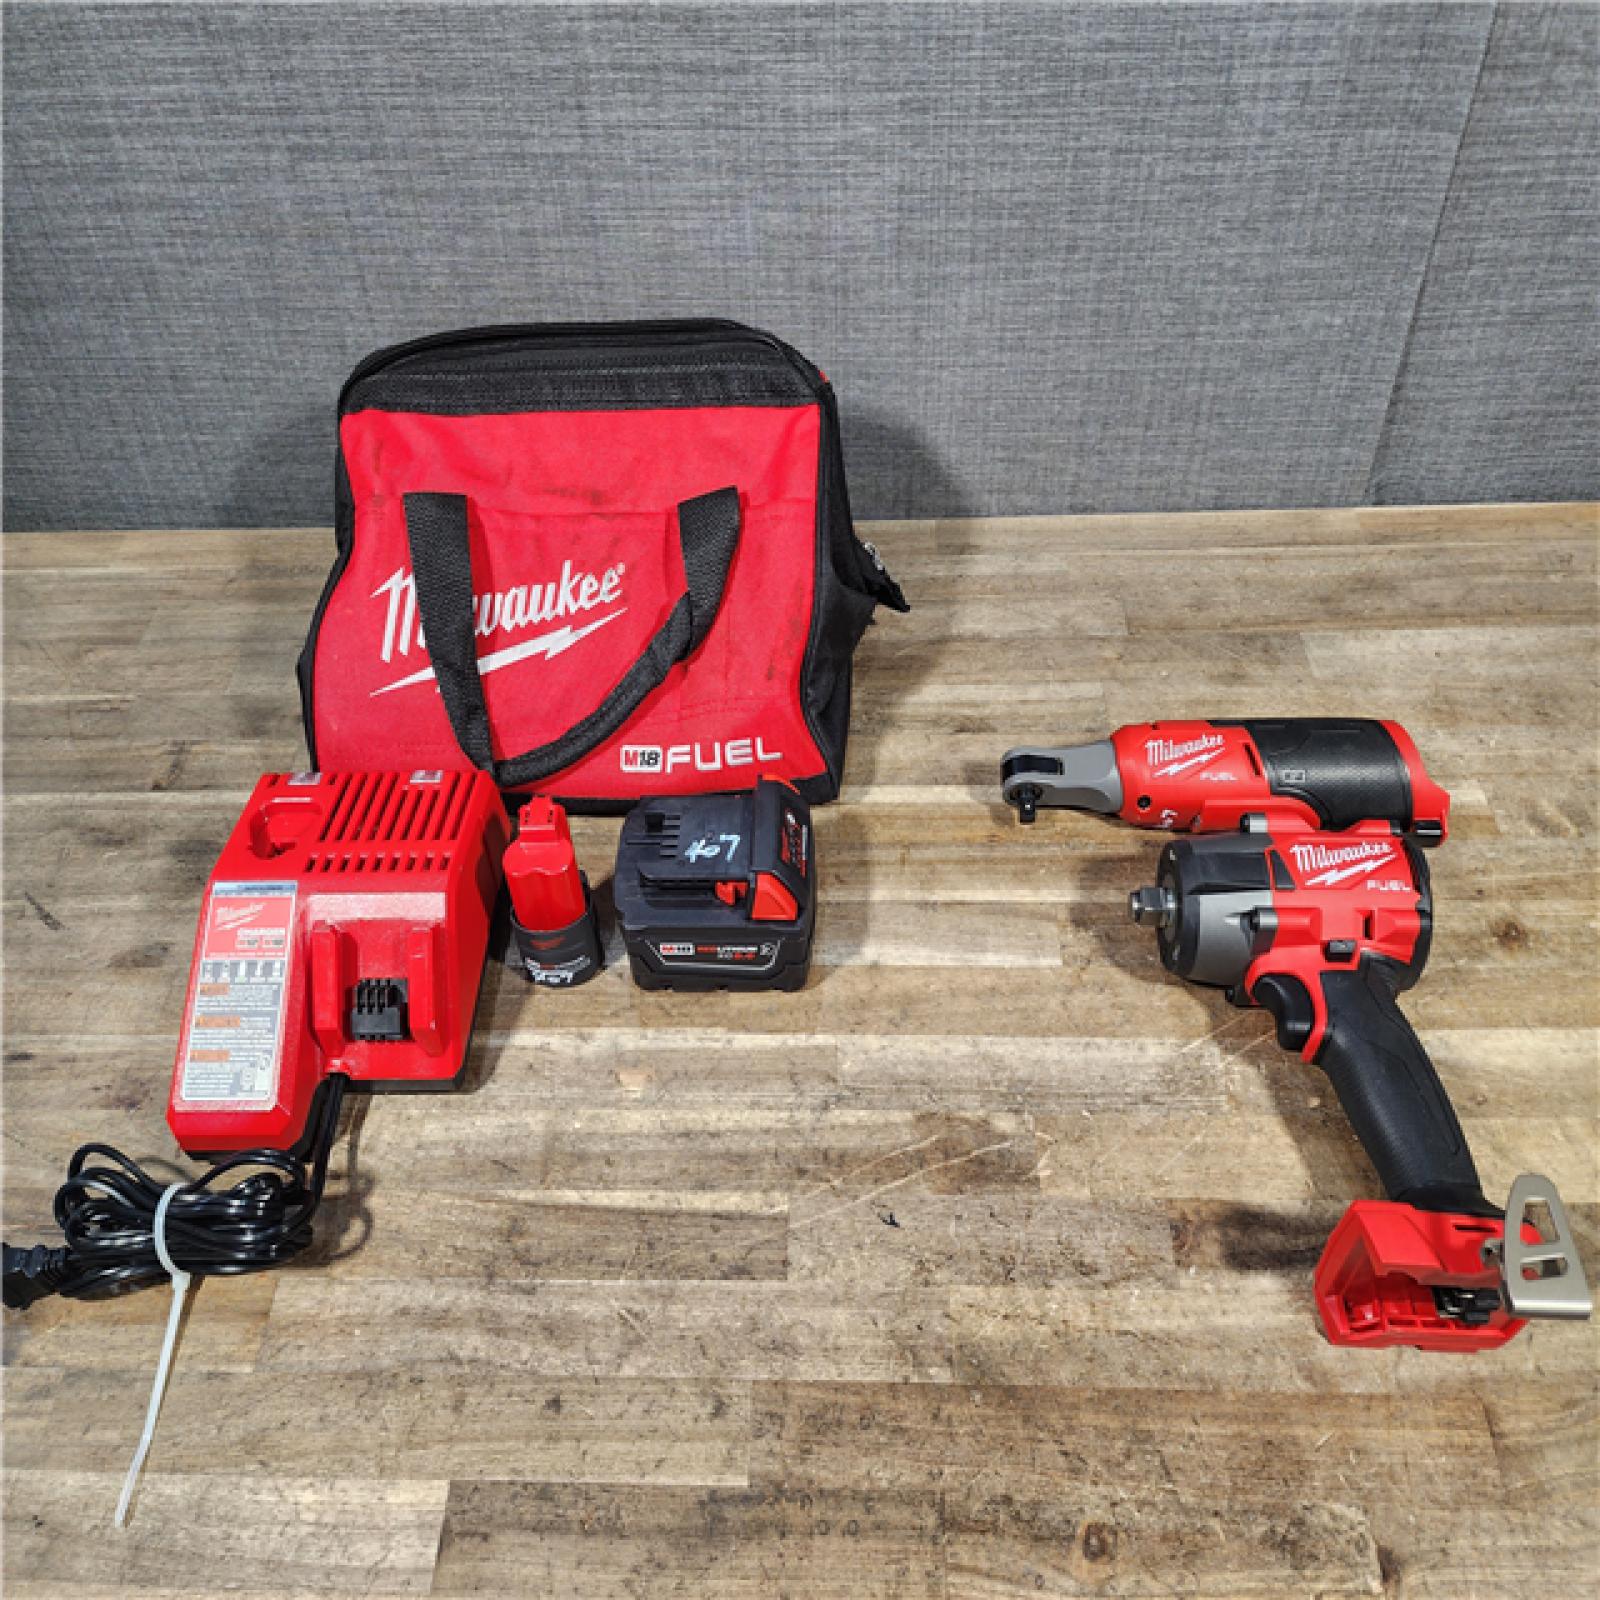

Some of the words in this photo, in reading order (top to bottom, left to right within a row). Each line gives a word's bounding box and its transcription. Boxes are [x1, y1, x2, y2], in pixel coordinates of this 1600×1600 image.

[664, 737, 783, 774] FUEL
[1144, 733, 1226, 767] Milwaukee
[1289, 841, 1393, 873] Milwaukee
